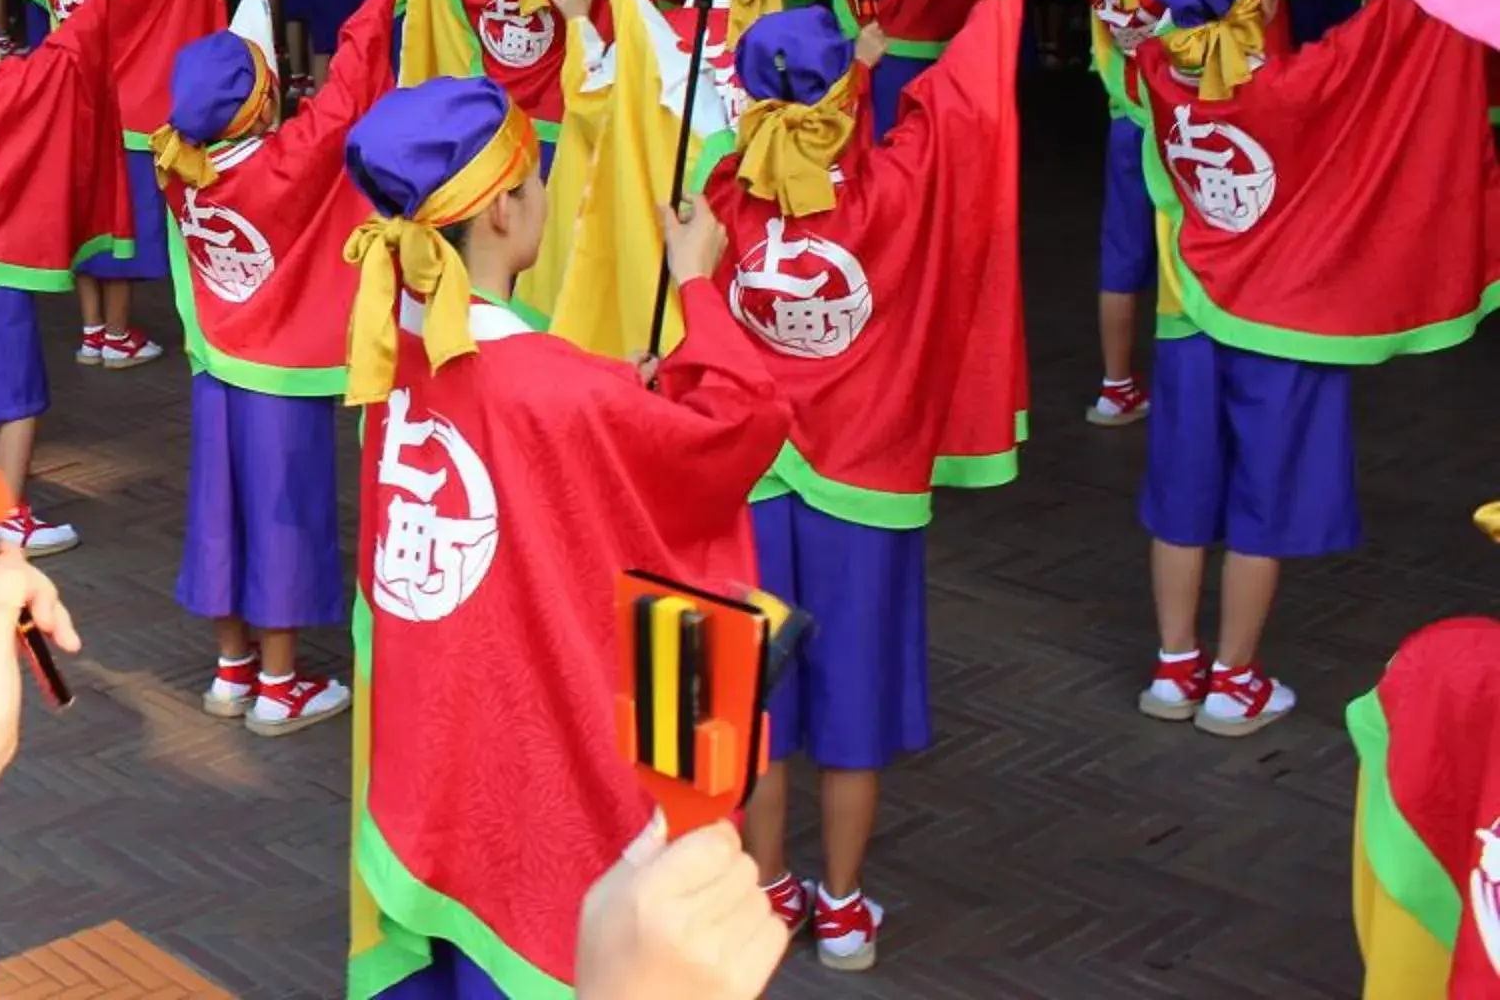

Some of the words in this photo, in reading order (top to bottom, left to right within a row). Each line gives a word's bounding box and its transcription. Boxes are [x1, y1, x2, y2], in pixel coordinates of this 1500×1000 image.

[1165, 103, 1277, 233] 上町
[180, 186, 275, 304] 上町
[729, 216, 873, 359] 上町
[372, 387, 500, 622] 上町
